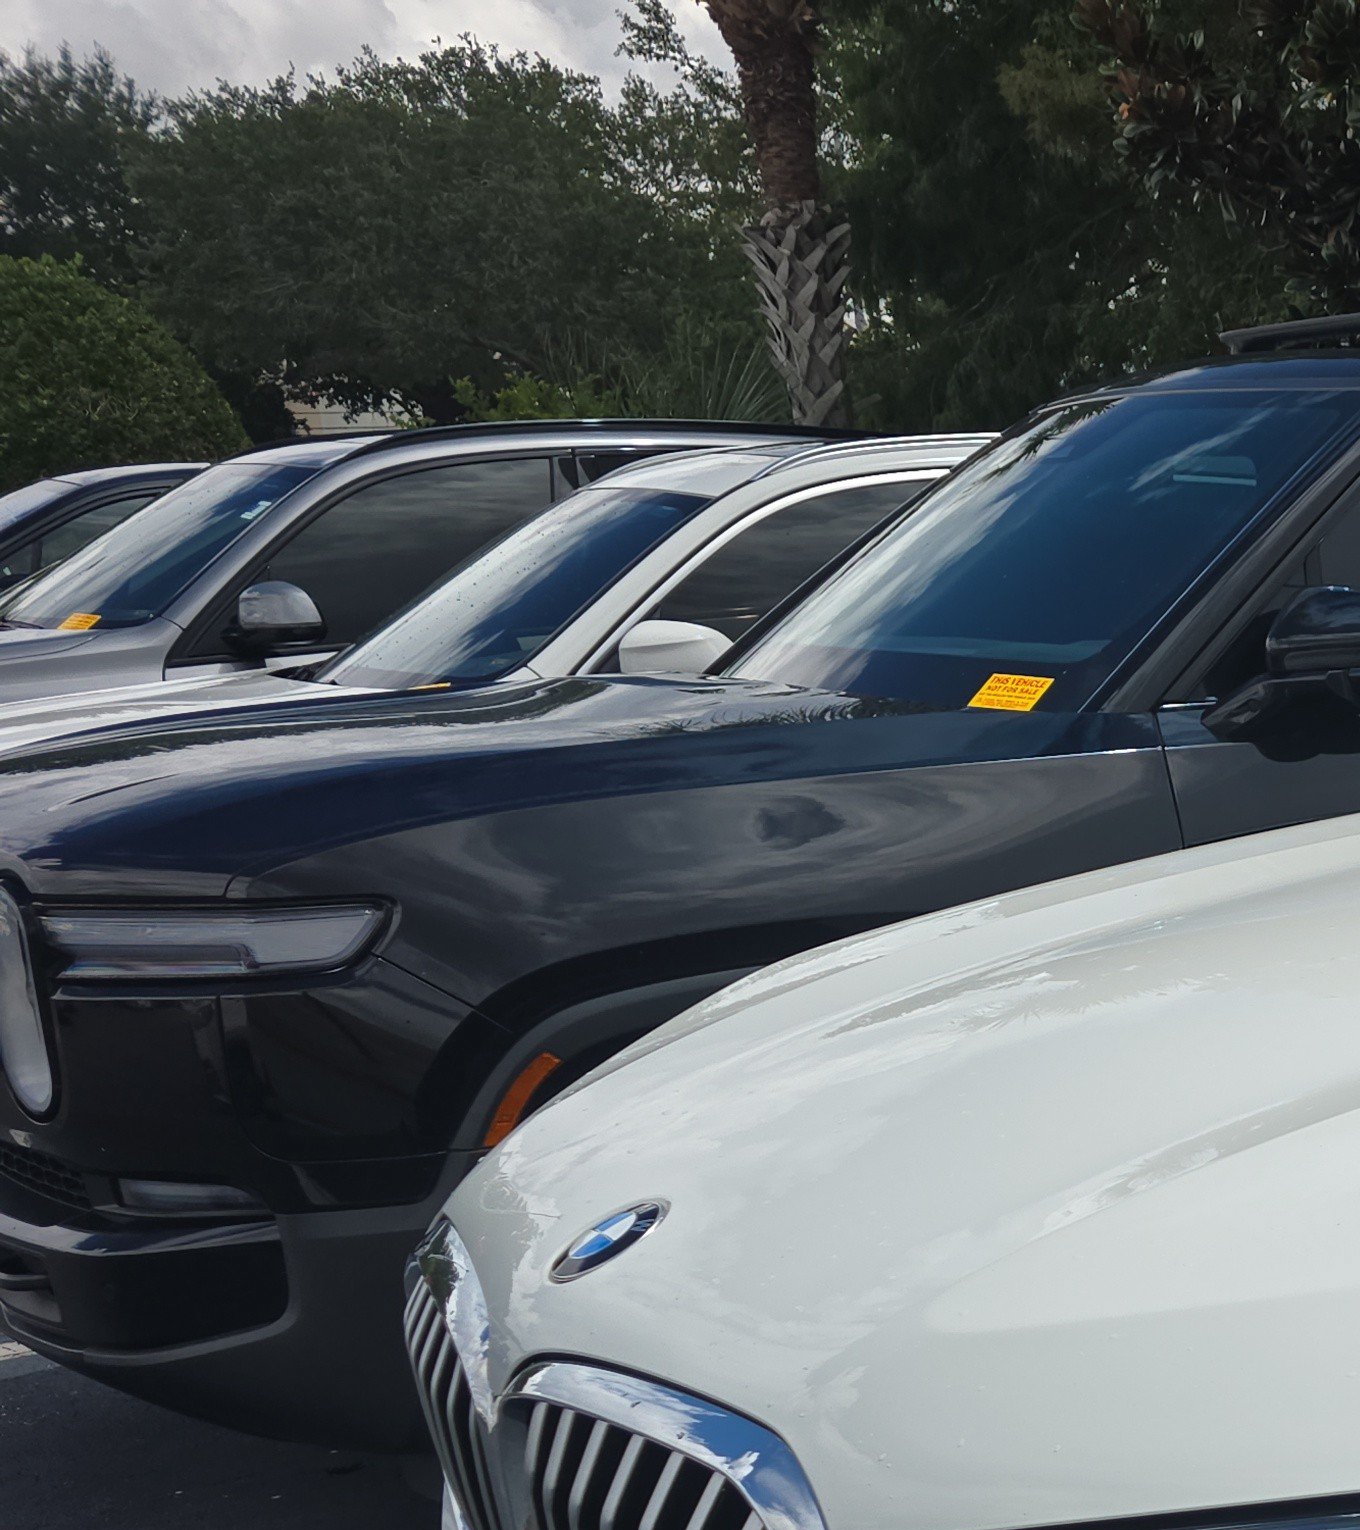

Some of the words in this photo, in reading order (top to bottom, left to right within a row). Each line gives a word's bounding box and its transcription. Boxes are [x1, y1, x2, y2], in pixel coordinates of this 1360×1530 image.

[991, 676, 1010, 685] THIS
[1011, 678, 1046, 688] VEHICLE
[1020, 687, 1039, 695] SALE
